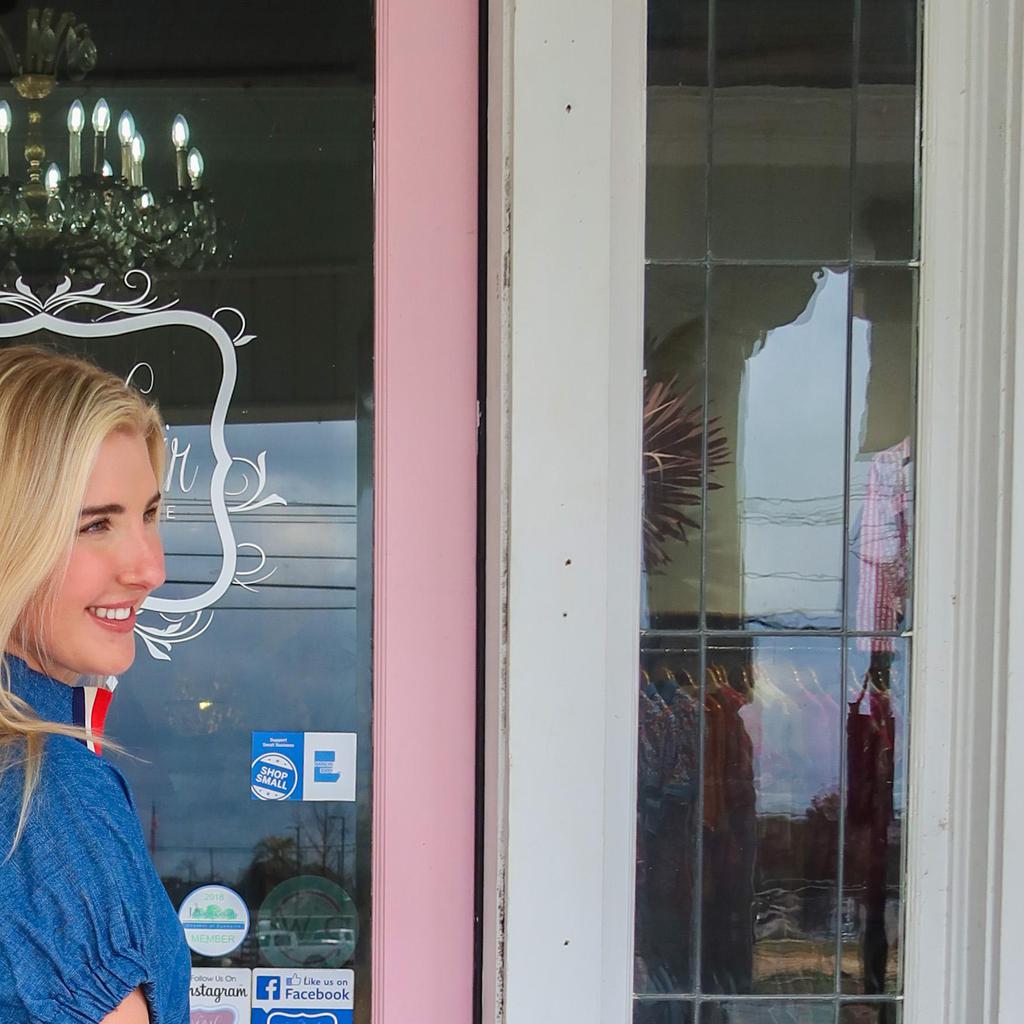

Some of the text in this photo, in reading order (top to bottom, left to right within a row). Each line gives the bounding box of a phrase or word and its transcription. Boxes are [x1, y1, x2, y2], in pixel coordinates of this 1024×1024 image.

[260, 766, 288, 780] SHOP
[255, 774, 288, 790] SMALL
[191, 934, 236, 944] MEMBER
[215, 974, 224, 982] Us
[224, 974, 237, 982] On
[303, 976, 321, 986] Like
[189, 983, 248, 1003] nstagram
[285, 988, 350, 1000] Facebook
